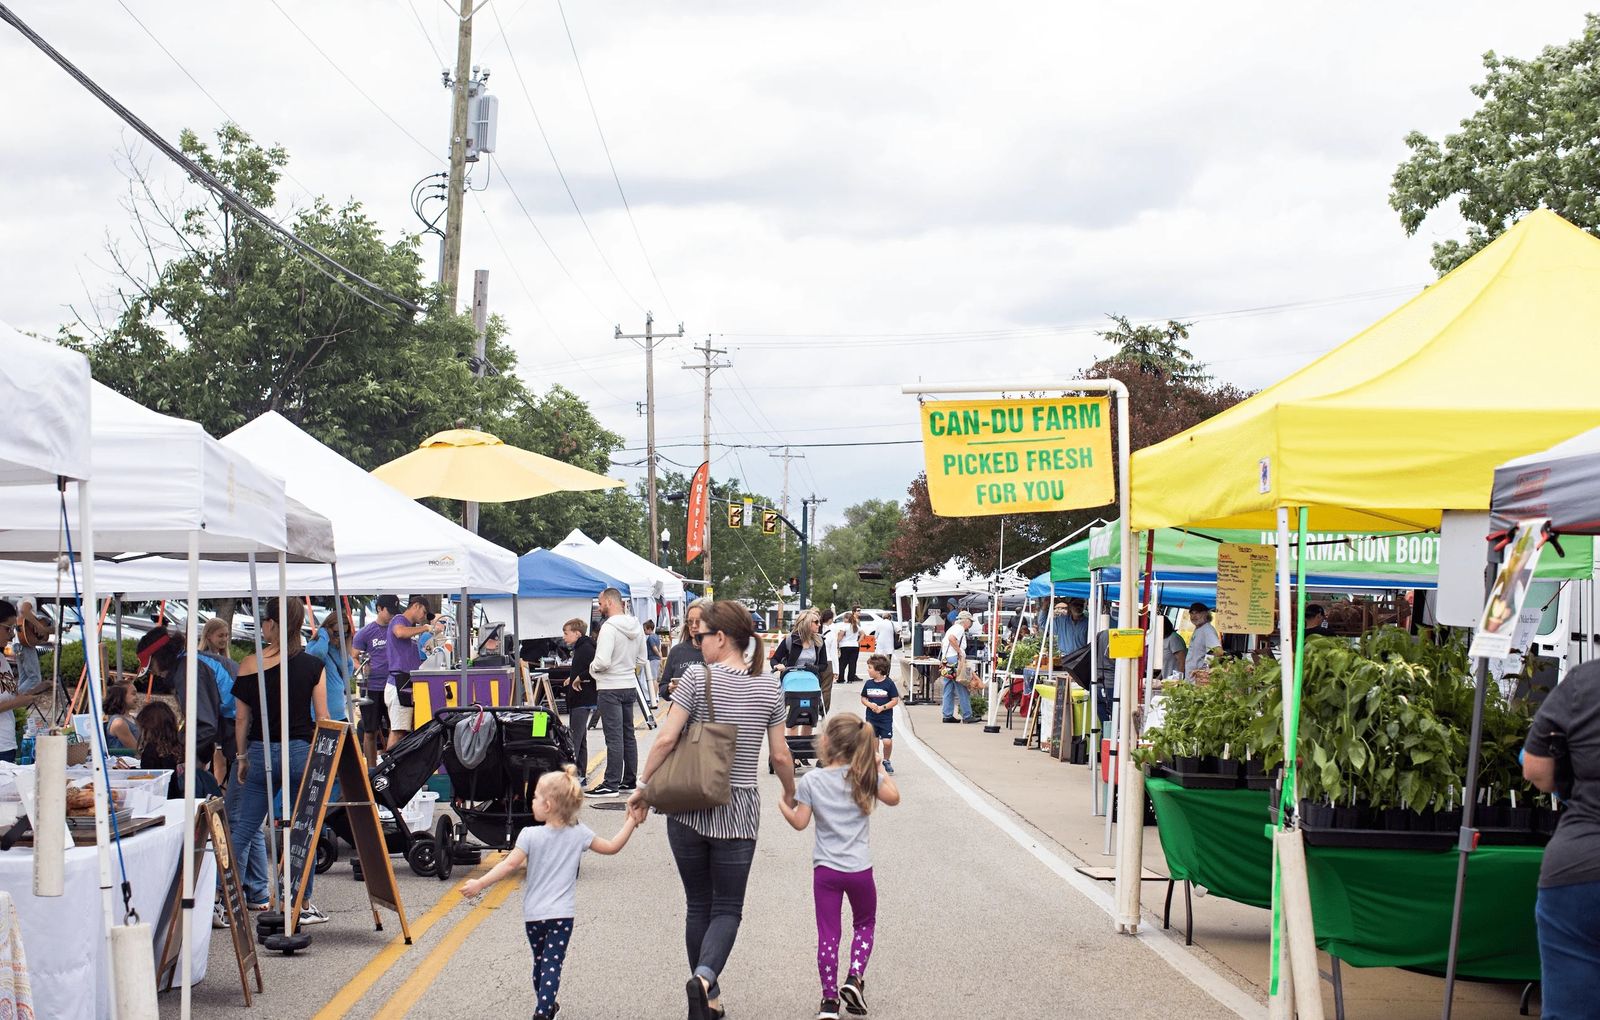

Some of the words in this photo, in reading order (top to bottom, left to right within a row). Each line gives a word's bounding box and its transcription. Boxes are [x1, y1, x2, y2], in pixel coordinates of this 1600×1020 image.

[930, 408, 1023, 436] CAN-DU
[1033, 403, 1101, 431] FARM
[943, 451, 1019, 475] PICKED
[1026, 447, 1093, 471] FRESH
[976, 482, 1017, 505] FOR
[1024, 480, 1064, 501] YOU
[1260, 532, 1390, 562] INORMATION
